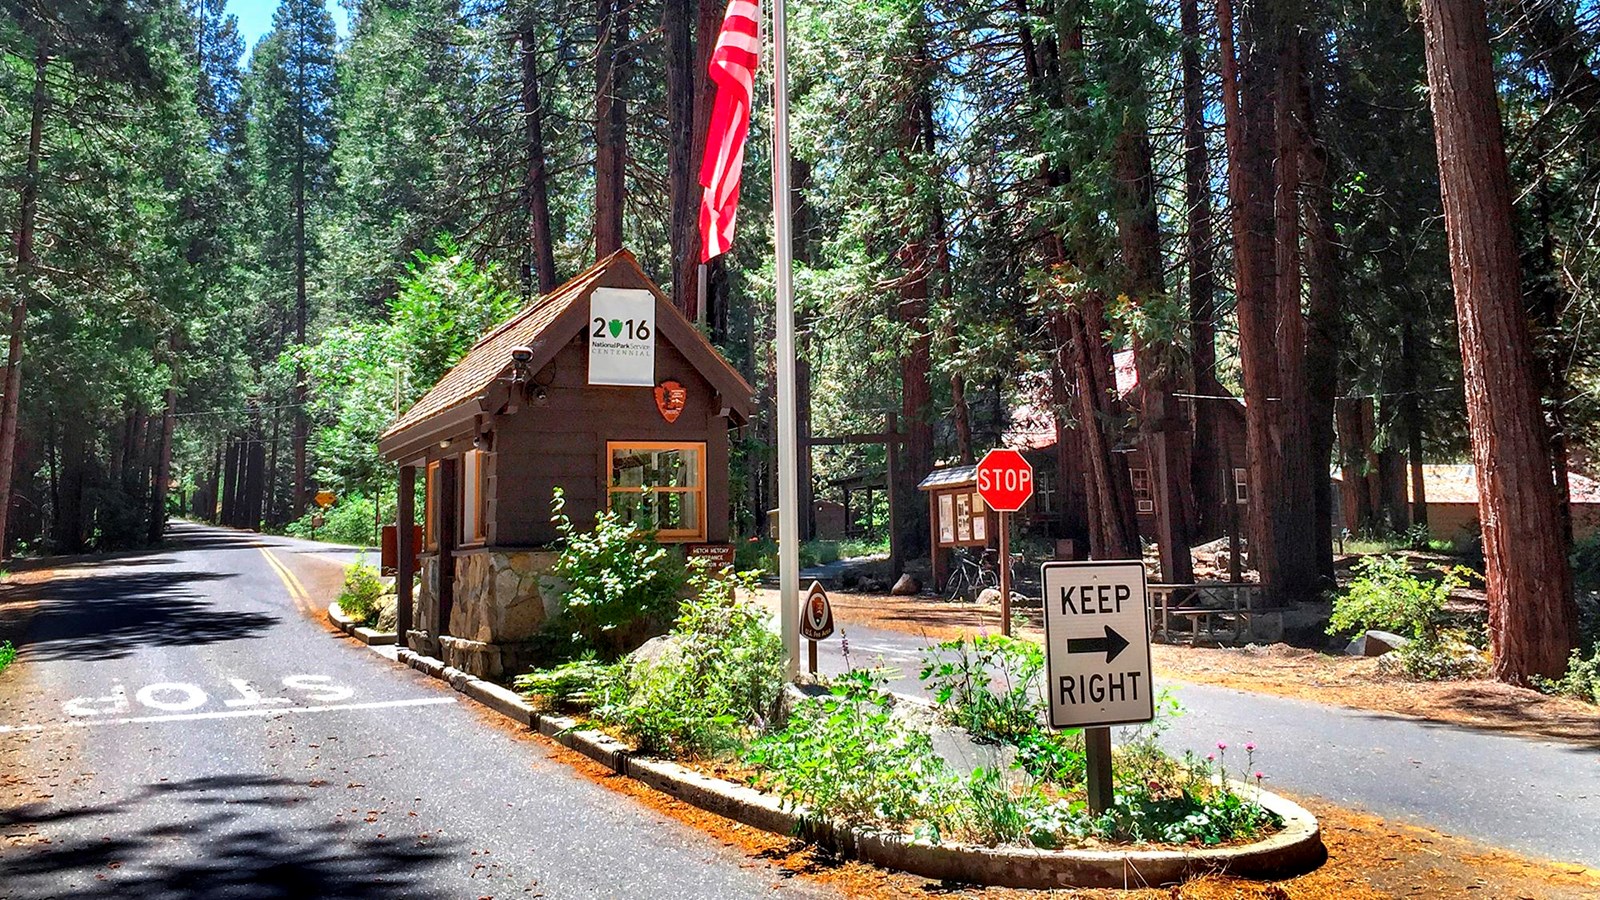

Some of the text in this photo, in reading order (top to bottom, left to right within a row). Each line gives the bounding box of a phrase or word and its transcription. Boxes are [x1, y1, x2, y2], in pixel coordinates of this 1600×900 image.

[592, 349, 650, 357] CENTENNIAL
[979, 468, 1031, 492] STOP
[1060, 584, 1131, 616] KEEP
[61, 674, 354, 717] STOP
[1059, 671, 1141, 706] RIGHT
